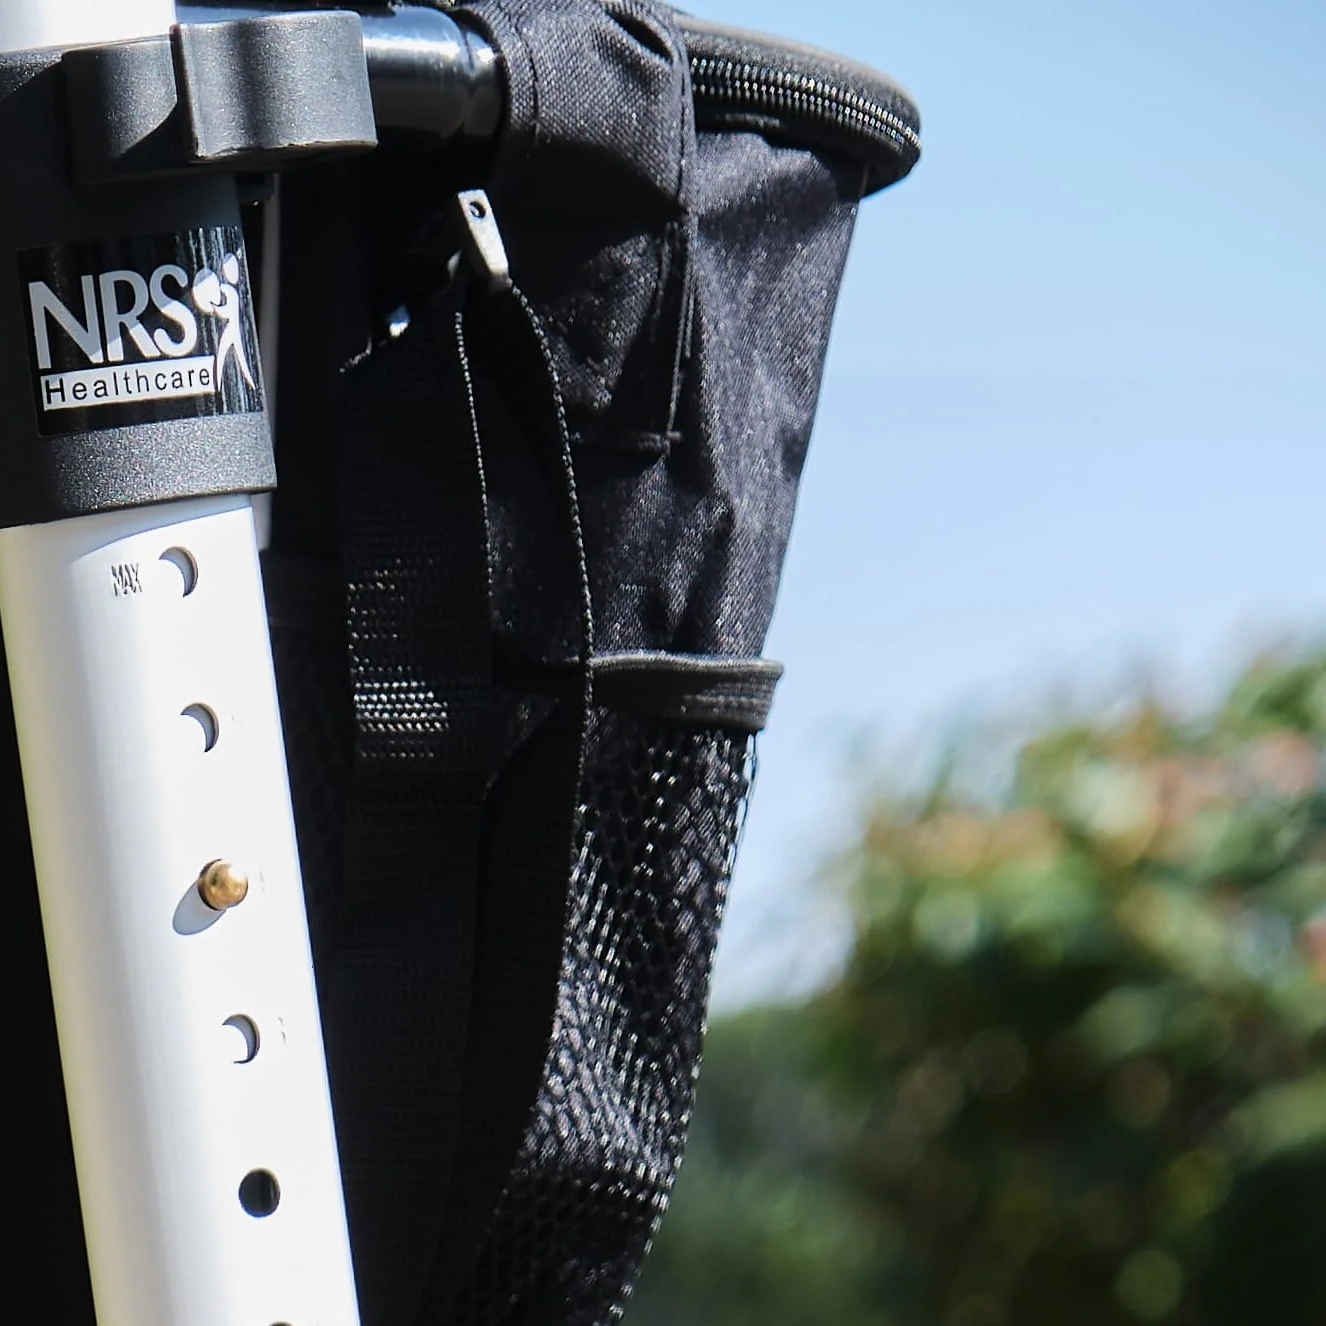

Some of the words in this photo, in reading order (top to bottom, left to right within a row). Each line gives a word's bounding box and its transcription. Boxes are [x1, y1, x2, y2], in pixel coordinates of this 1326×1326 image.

[28, 264, 198, 369] NRS
[45, 366, 211, 405] Healthcare
[111, 562, 143, 597] MAX
